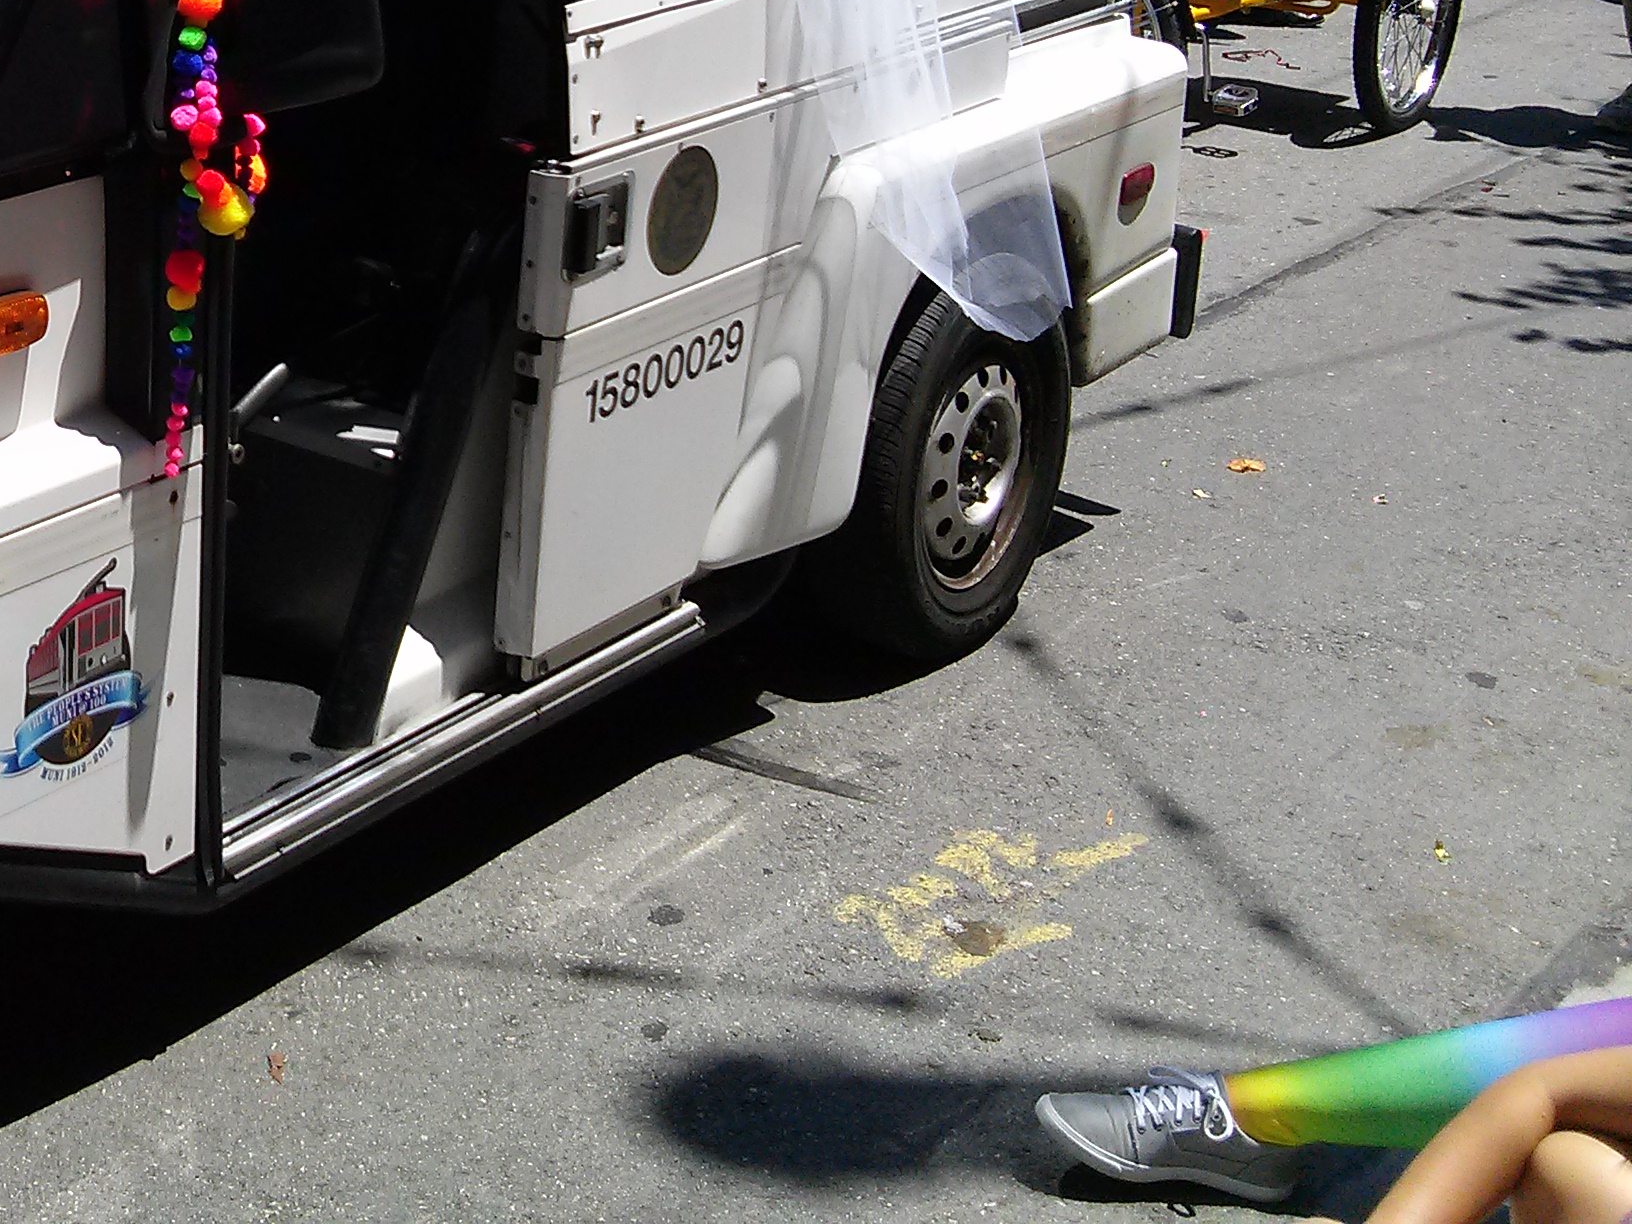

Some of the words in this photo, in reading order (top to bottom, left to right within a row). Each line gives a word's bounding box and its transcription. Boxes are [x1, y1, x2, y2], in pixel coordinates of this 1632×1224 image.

[585, 319, 744, 423] 15800029
[28, 712, 48, 732] THE
[52, 705, 77, 727] MUNI
[89, 694, 106, 710] 100
[40, 766, 65, 782] MUNI
